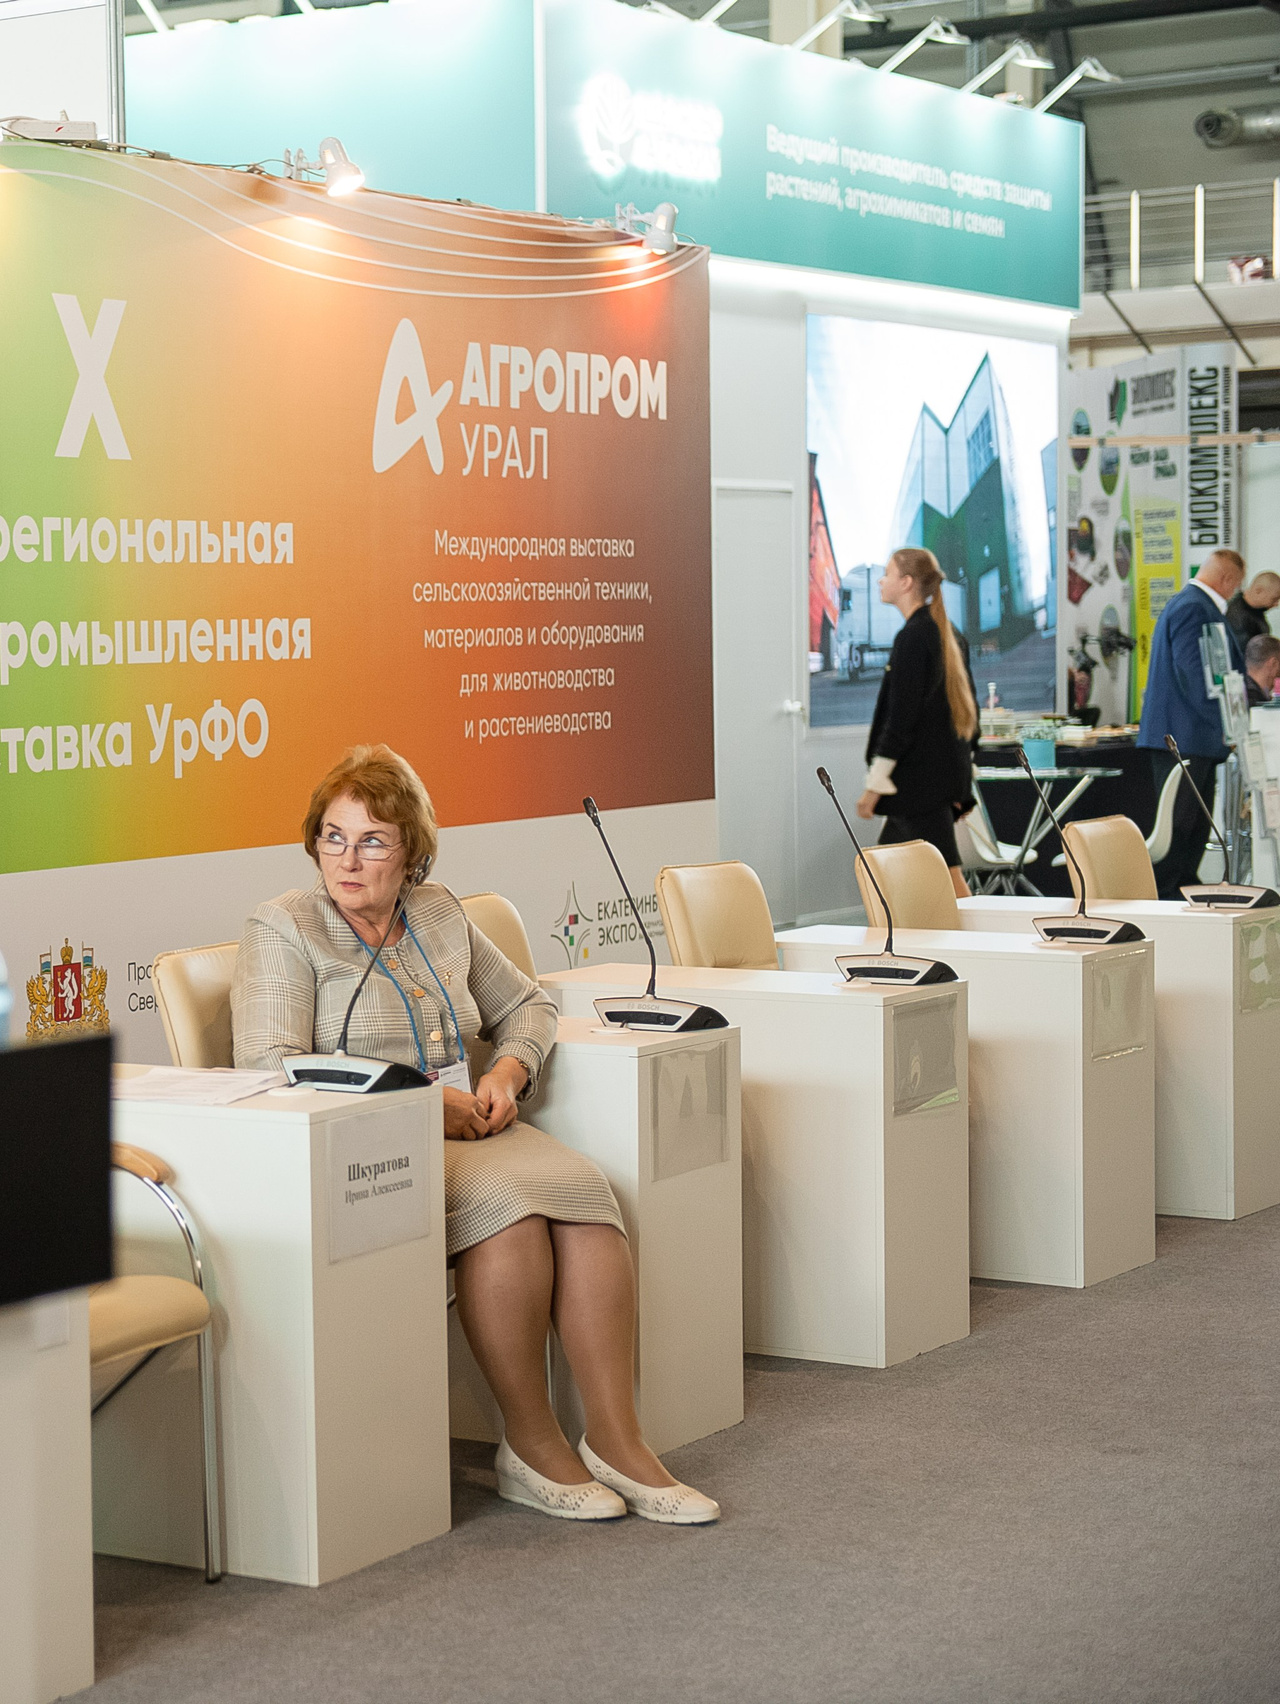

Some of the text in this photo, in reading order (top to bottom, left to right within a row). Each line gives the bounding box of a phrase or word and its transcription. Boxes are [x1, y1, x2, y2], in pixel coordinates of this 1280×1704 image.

[765, 123, 840, 166] Ведущий
[841, 146, 949, 189] производитель
[459, 341, 668, 421] АГРОПРОМ
[459, 422, 548, 480] УРАЛ
[1189, 366, 1219, 547] БИОКОМЛЕКС
[434, 529, 635, 562] Международная выставка
[412, 577, 652, 604] сельскохозяйственной техники,
[424, 620, 645, 654] материалов и оборудования
[459, 667, 615, 698] для животноводства
[145, 698, 270, 779] УрФО
[464, 710, 612, 744] и растениеводства
[598, 922, 638, 946] ЭКСПО
[347, 1155, 410, 1182] Шкуратова
[345, 1177, 414, 1206] Ирина Алексеевна
